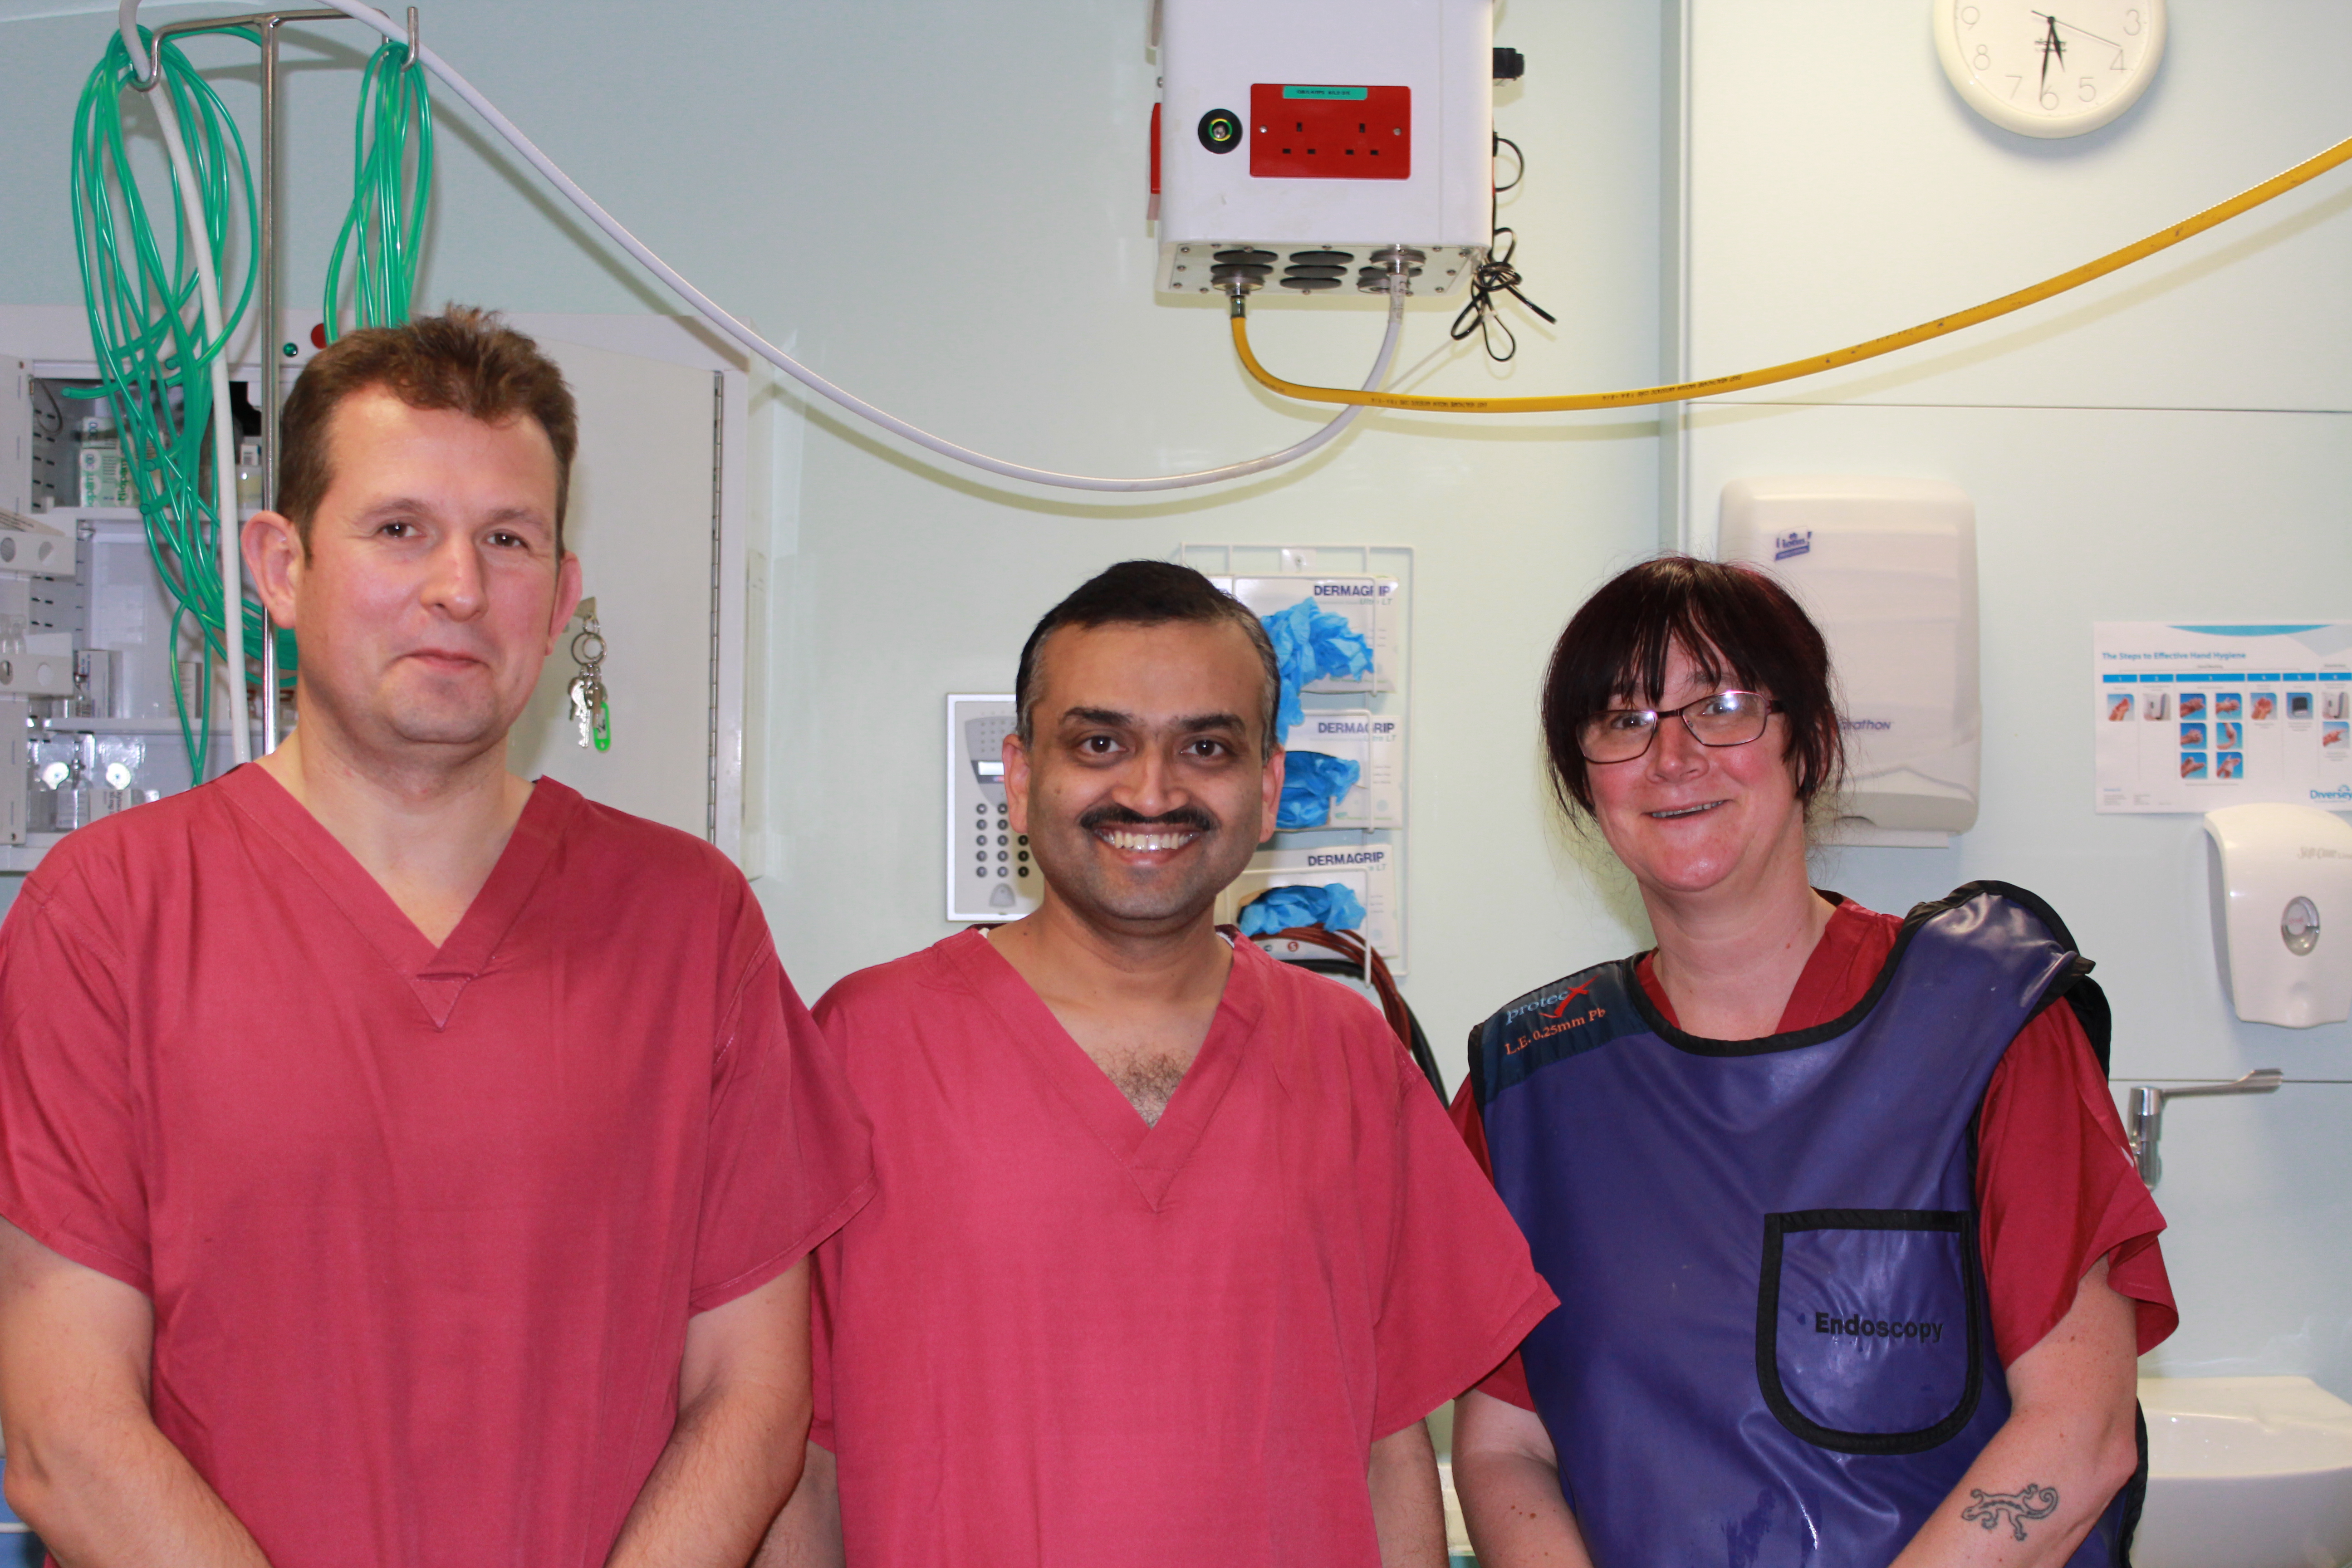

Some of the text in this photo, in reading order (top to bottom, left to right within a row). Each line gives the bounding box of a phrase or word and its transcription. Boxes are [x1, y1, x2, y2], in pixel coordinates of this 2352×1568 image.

[1961, 6, 1980, 31] 9
[2123, 9, 2141, 35] 3
[1973, 44, 1990, 71] 8
[2109, 49, 2127, 73] 4
[2005, 75, 2023, 100] 7
[2041, 85, 2060, 111] 6
[2078, 77, 2097, 102] 5
[2120, 652, 2141, 661] Steps
[2213, 652, 2246, 661] Hygiene
[1308, 852, 1384, 866] DERMAGRIP
[1504, 1008, 1606, 1055] L.E. 0.25mm Pb
[1815, 1312, 1943, 1343] Endoscopy
